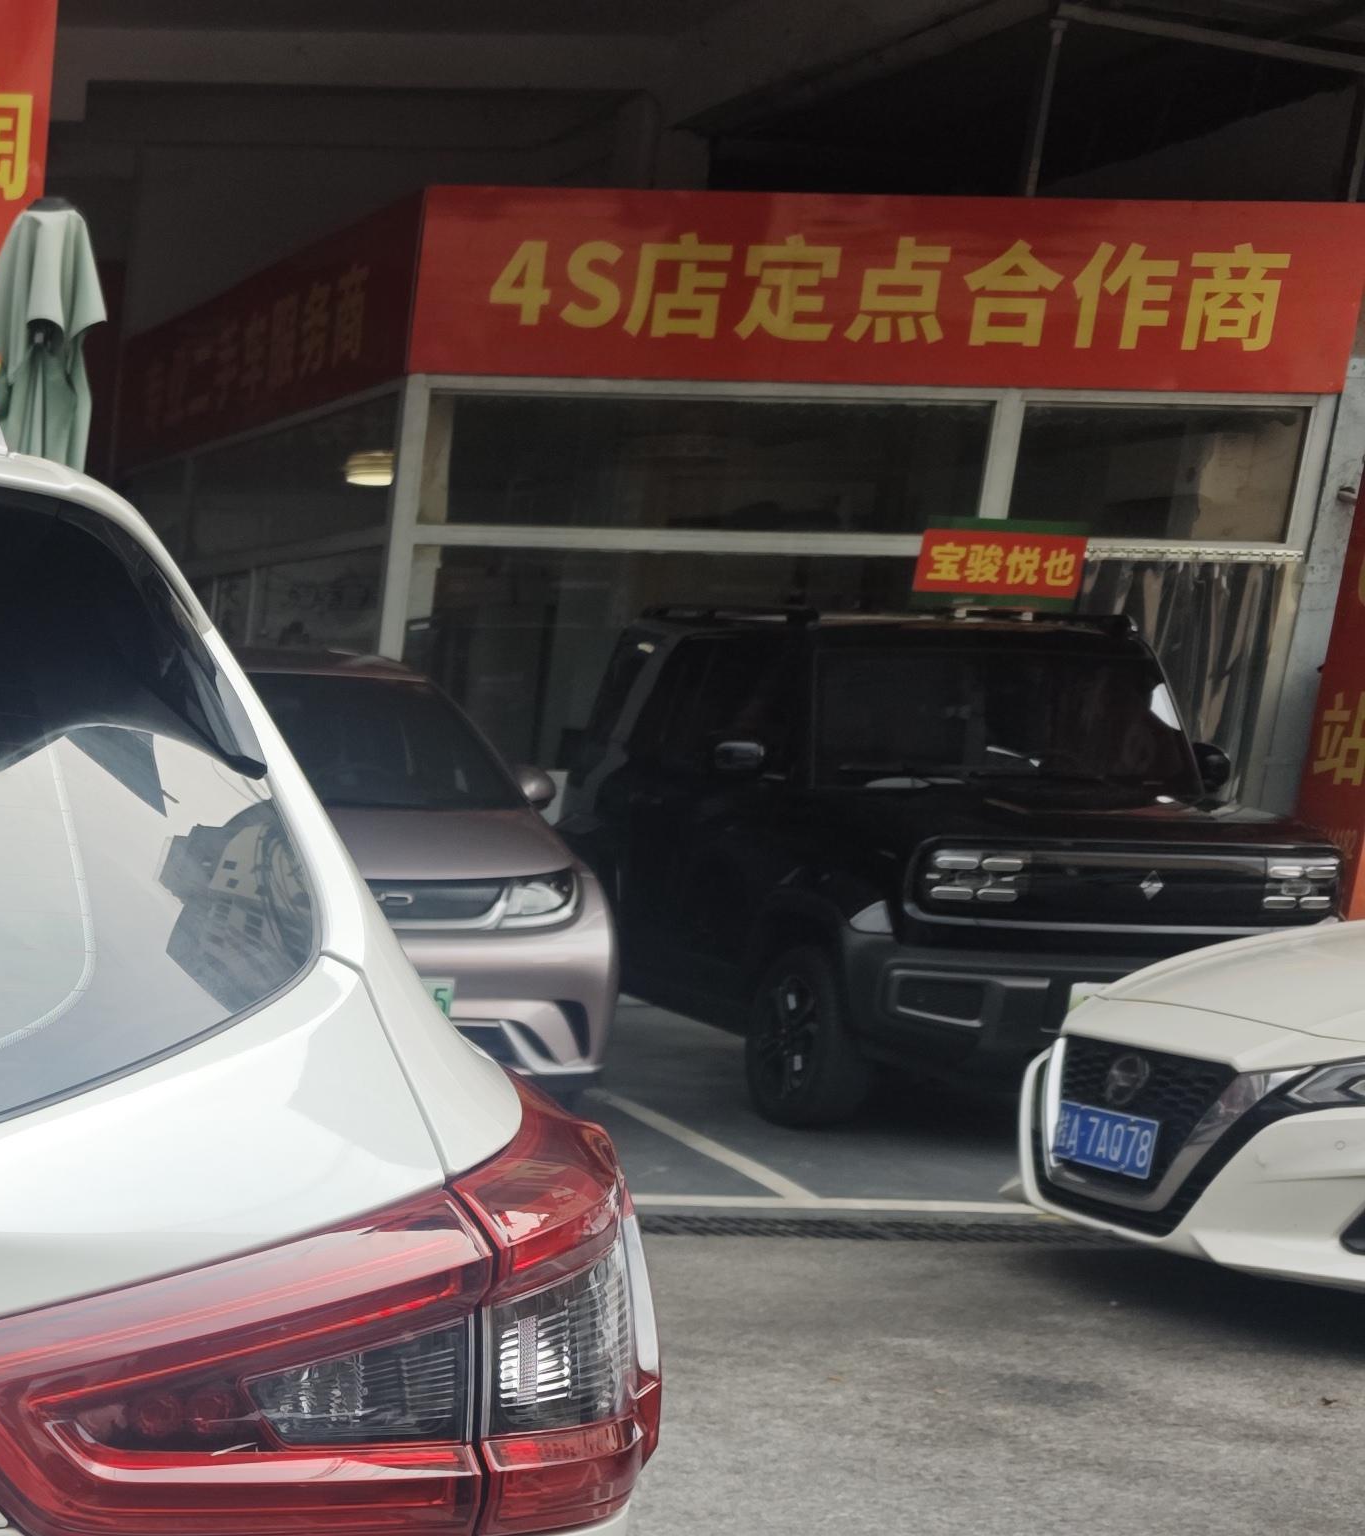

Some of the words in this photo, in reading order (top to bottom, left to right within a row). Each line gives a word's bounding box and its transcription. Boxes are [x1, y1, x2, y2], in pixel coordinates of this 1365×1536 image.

[488, 233, 1292, 352] 4S店定点合作商
[925, 541, 1076, 587] 宝骏悦也
